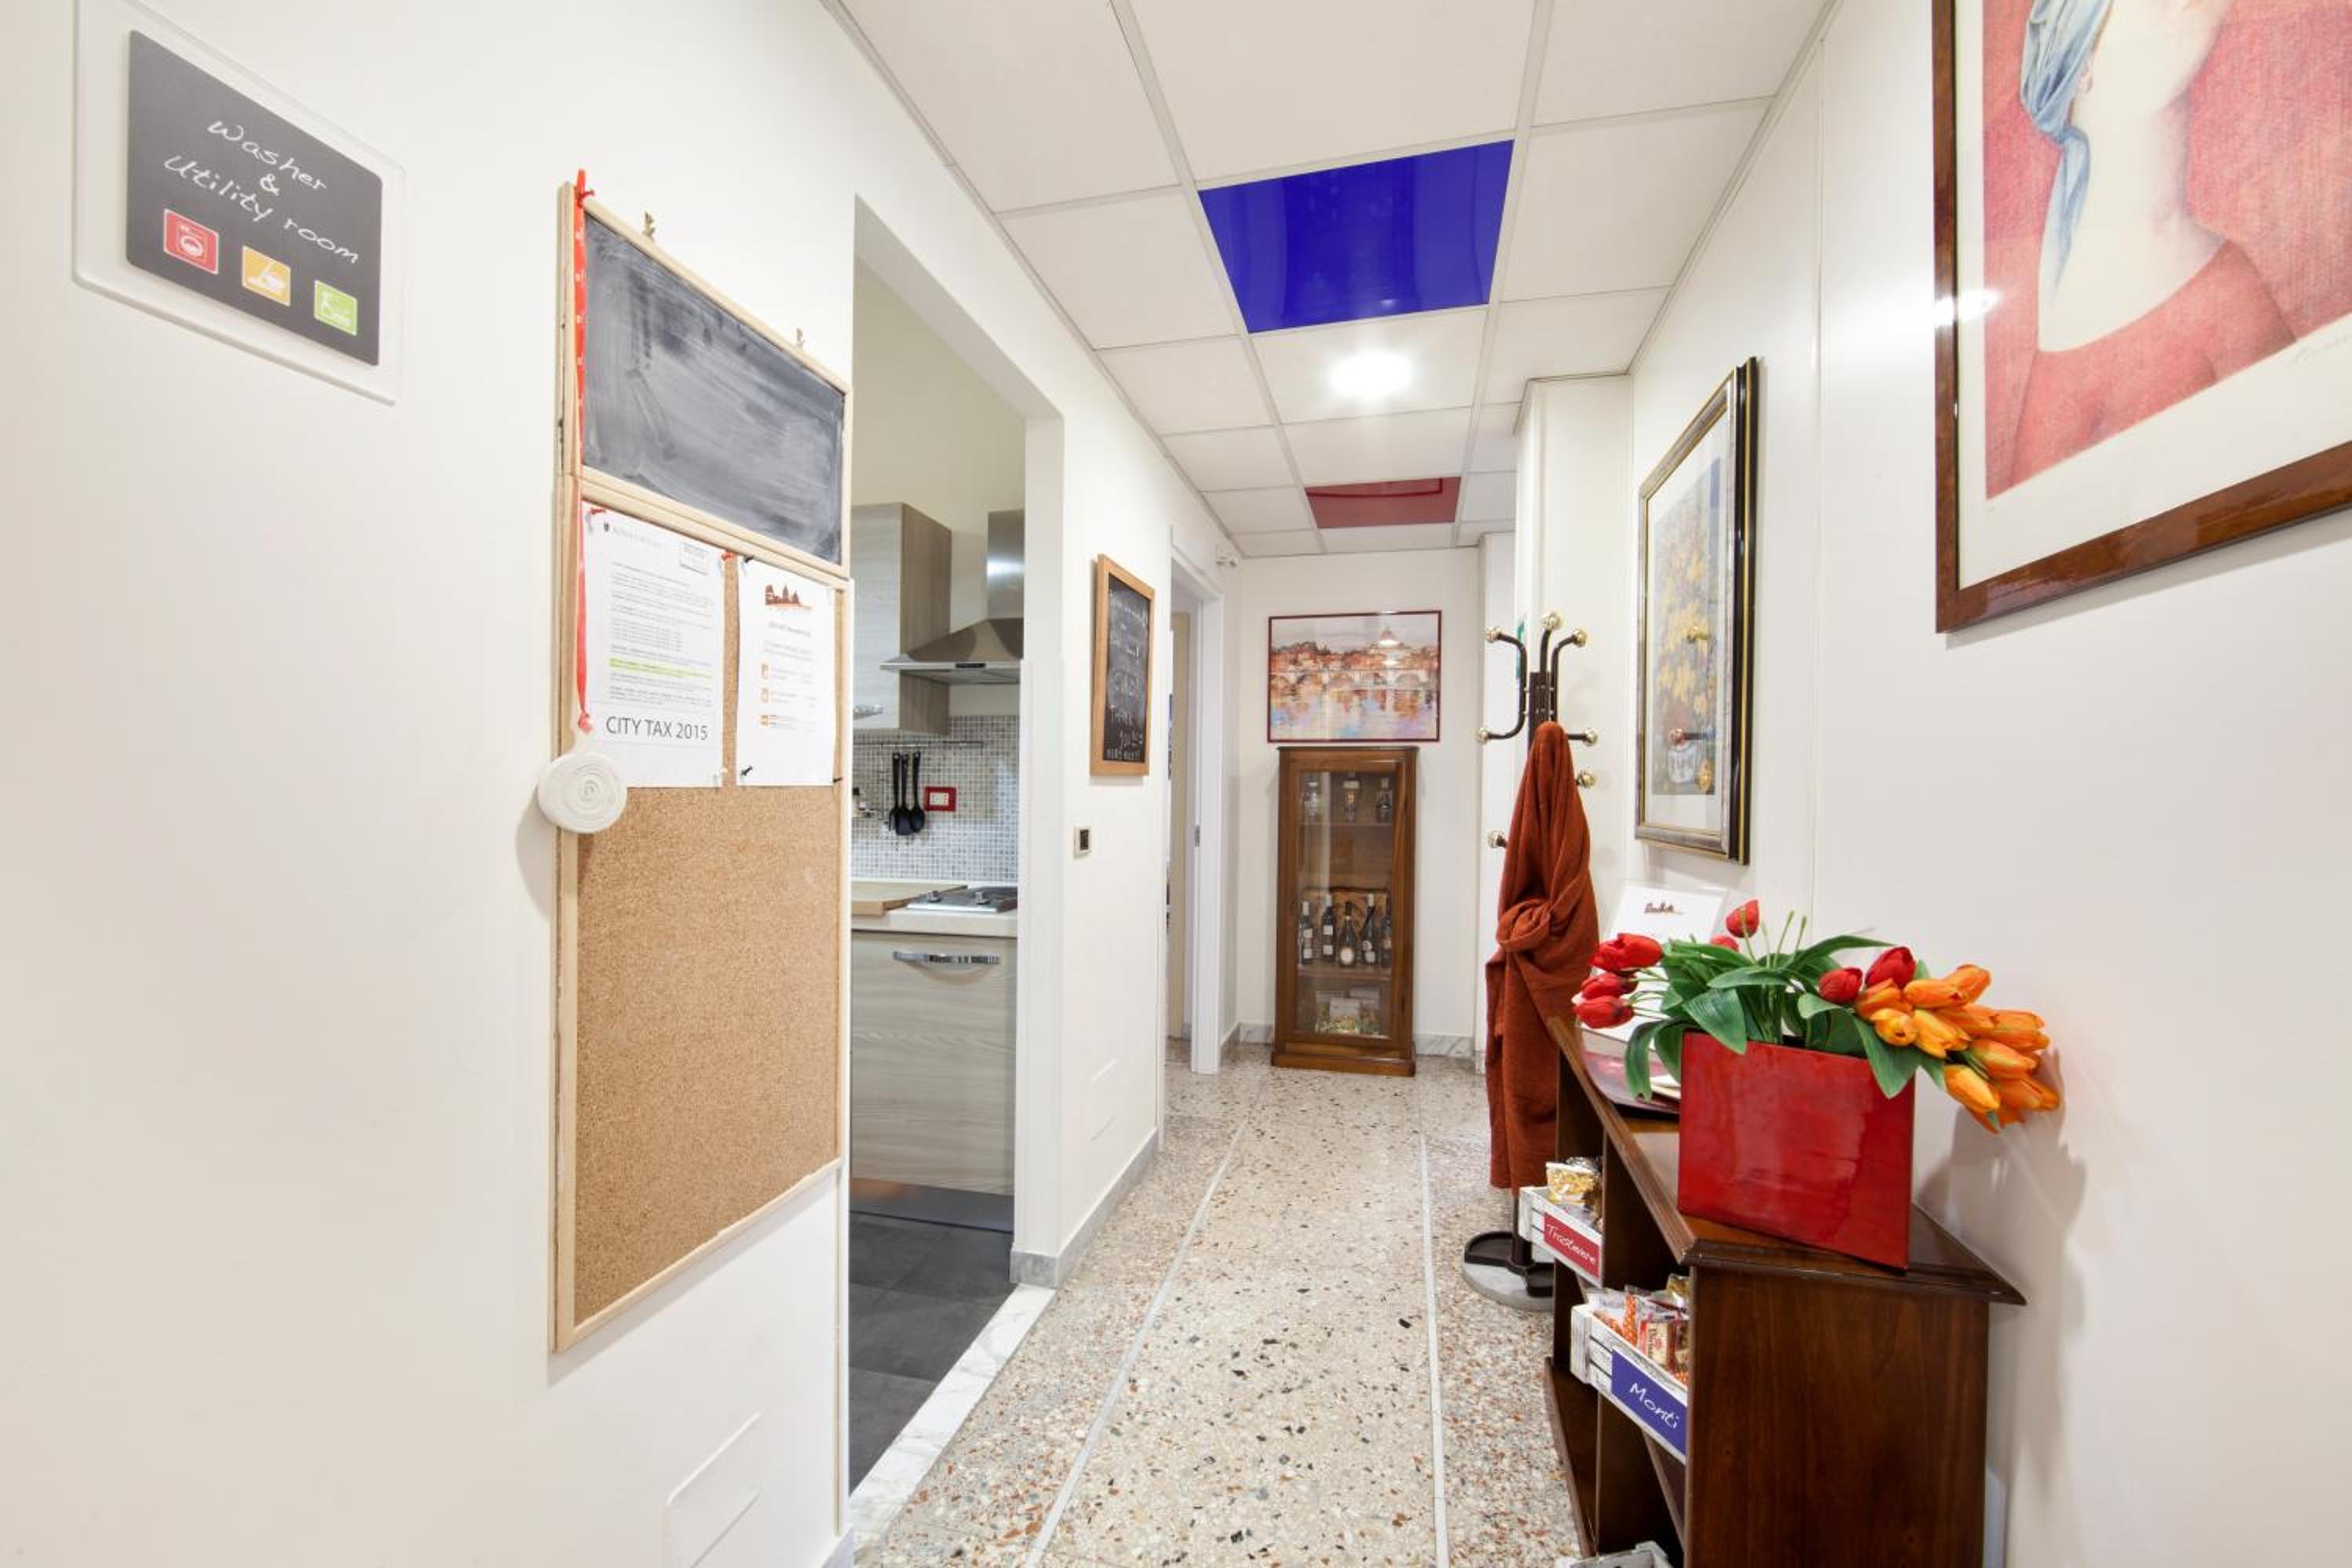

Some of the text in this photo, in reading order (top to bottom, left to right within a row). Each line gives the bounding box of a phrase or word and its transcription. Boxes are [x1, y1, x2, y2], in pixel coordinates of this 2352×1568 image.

[207, 120, 327, 191] Washer
[260, 172, 281, 197] &
[163, 155, 359, 264] Utility room
[605, 716, 709, 741] CITY TAX 2015
[1629, 1381, 1680, 1430] Monti
